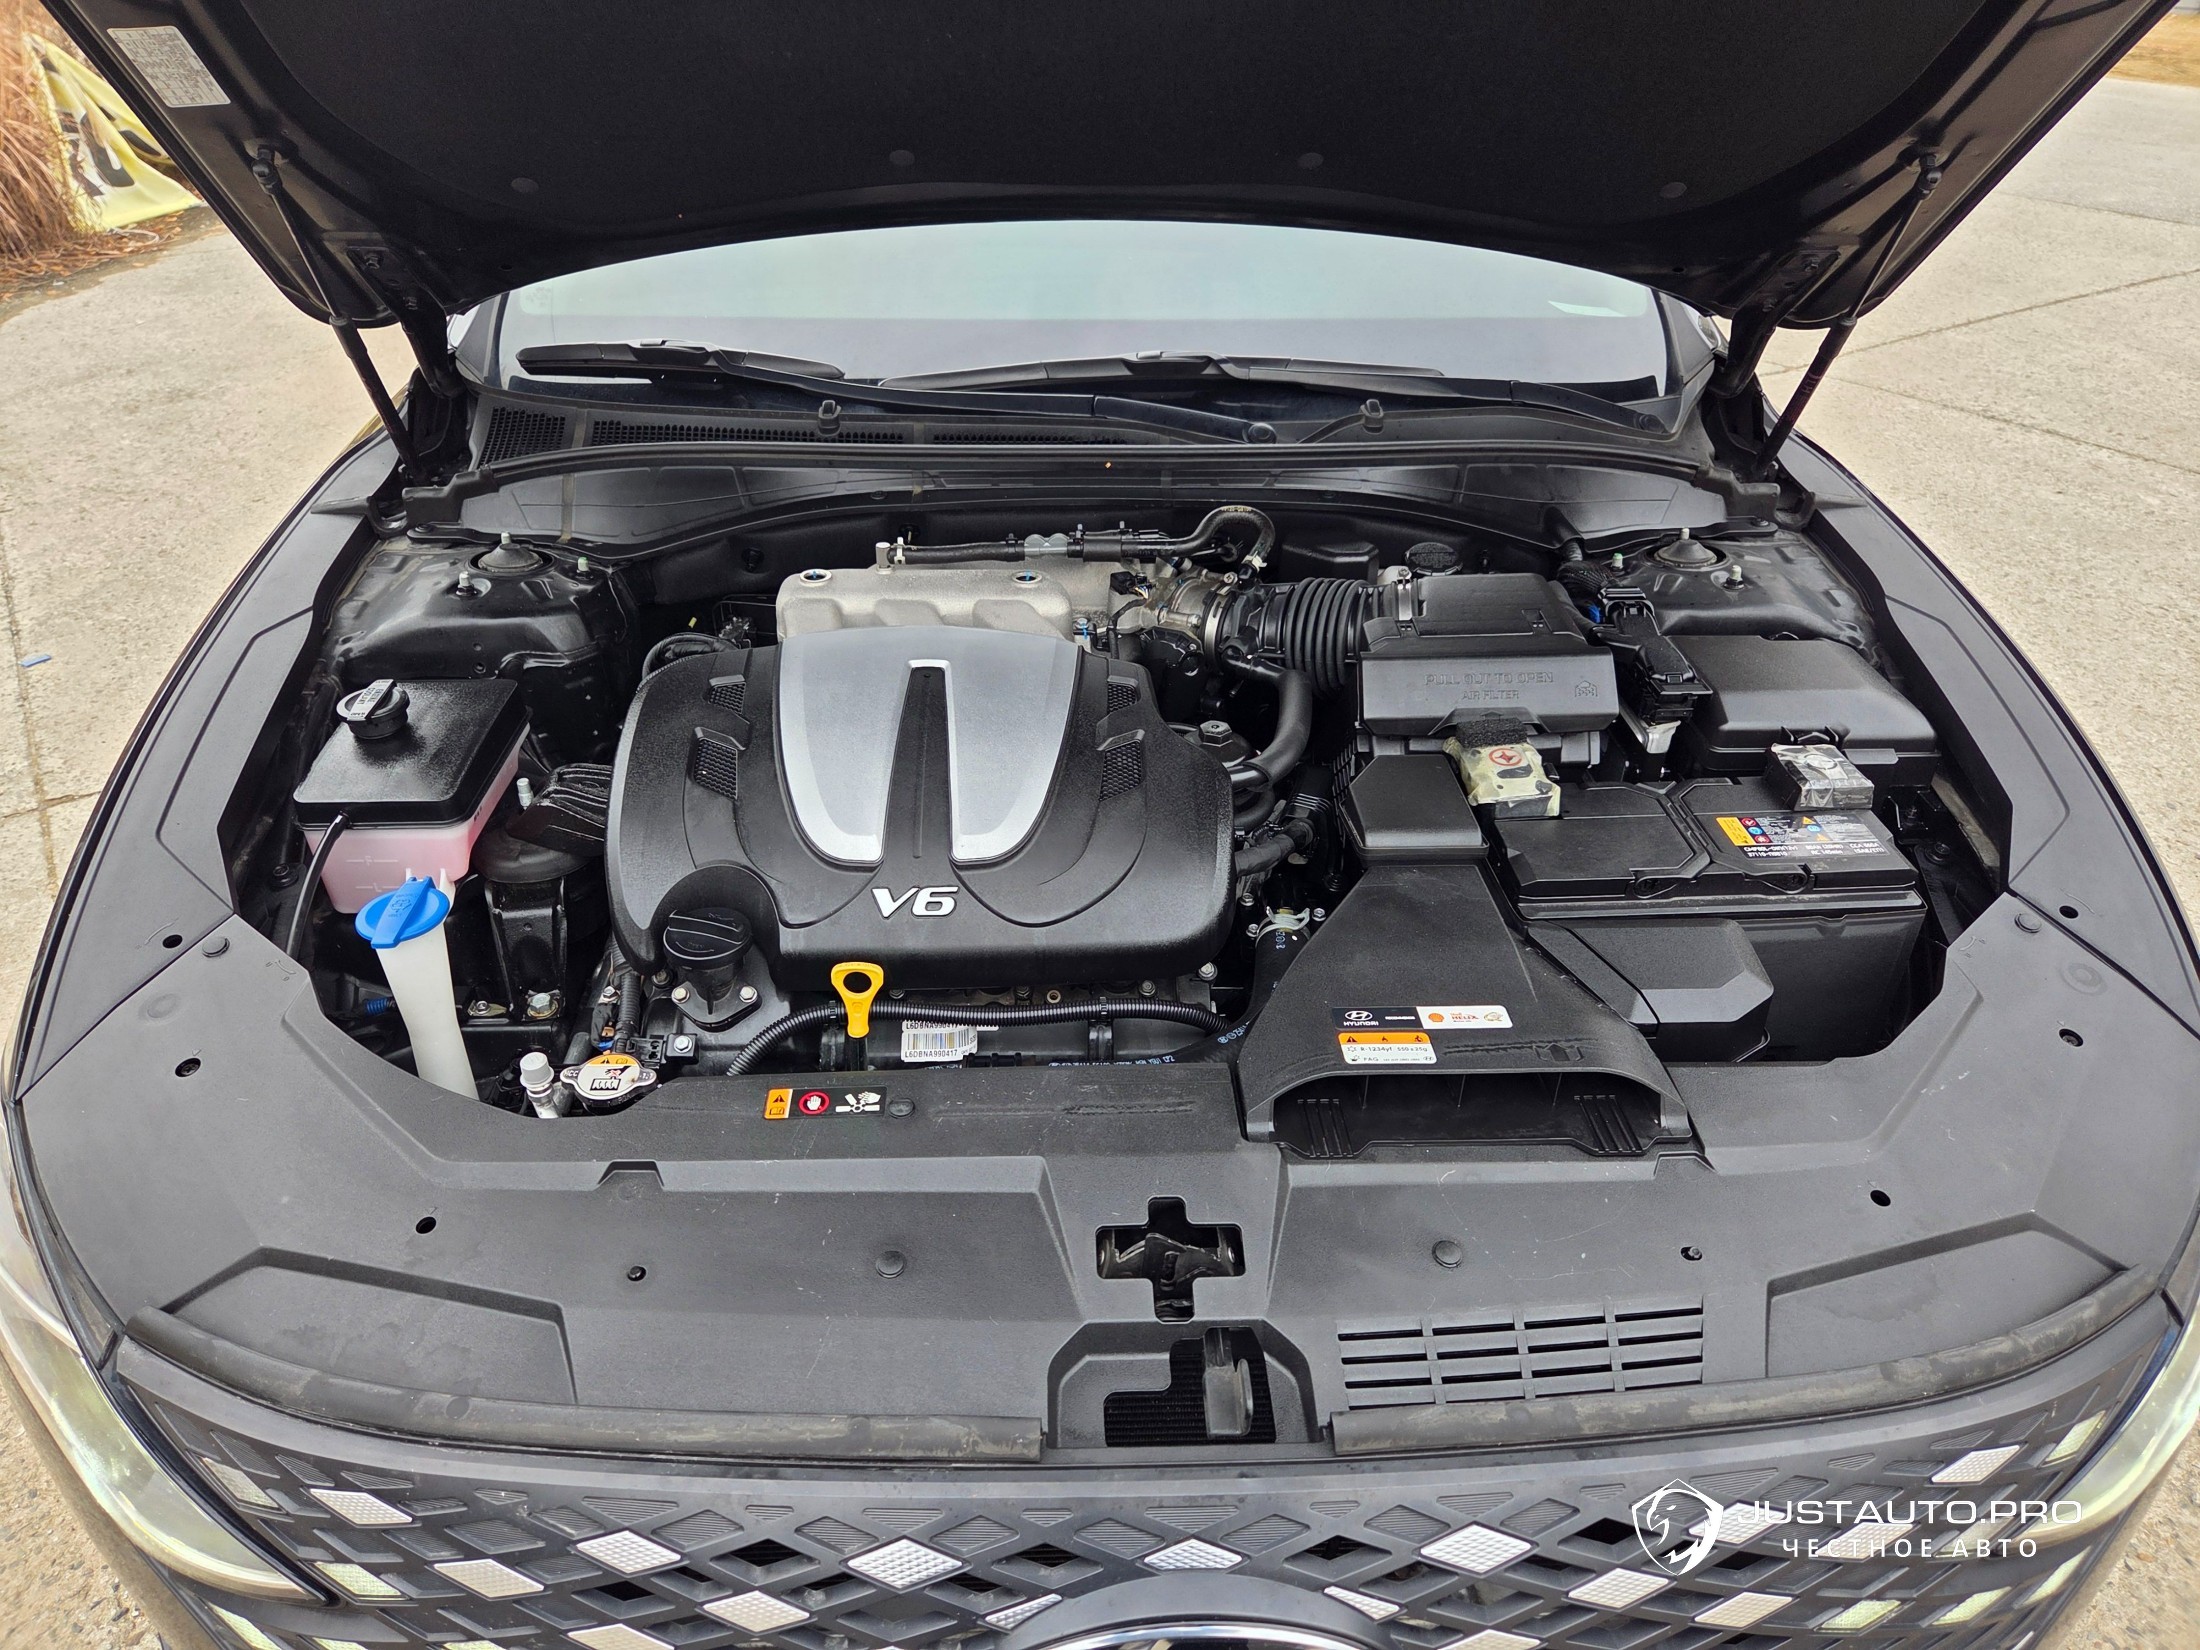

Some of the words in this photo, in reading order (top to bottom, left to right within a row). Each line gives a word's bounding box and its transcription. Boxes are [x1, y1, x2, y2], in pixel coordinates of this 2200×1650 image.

[1425, 673, 1460, 685] PULL
[1464, 673, 1491, 685] OUT
[1494, 673, 1513, 684] TO
[1517, 672, 1554, 684] OPEN
[1462, 690, 1480, 700] AIR
[1483, 690, 1520, 700] FILTER
[871, 886, 959, 918] V6
[904, 1049, 958, 1058] L6DBNA990417
